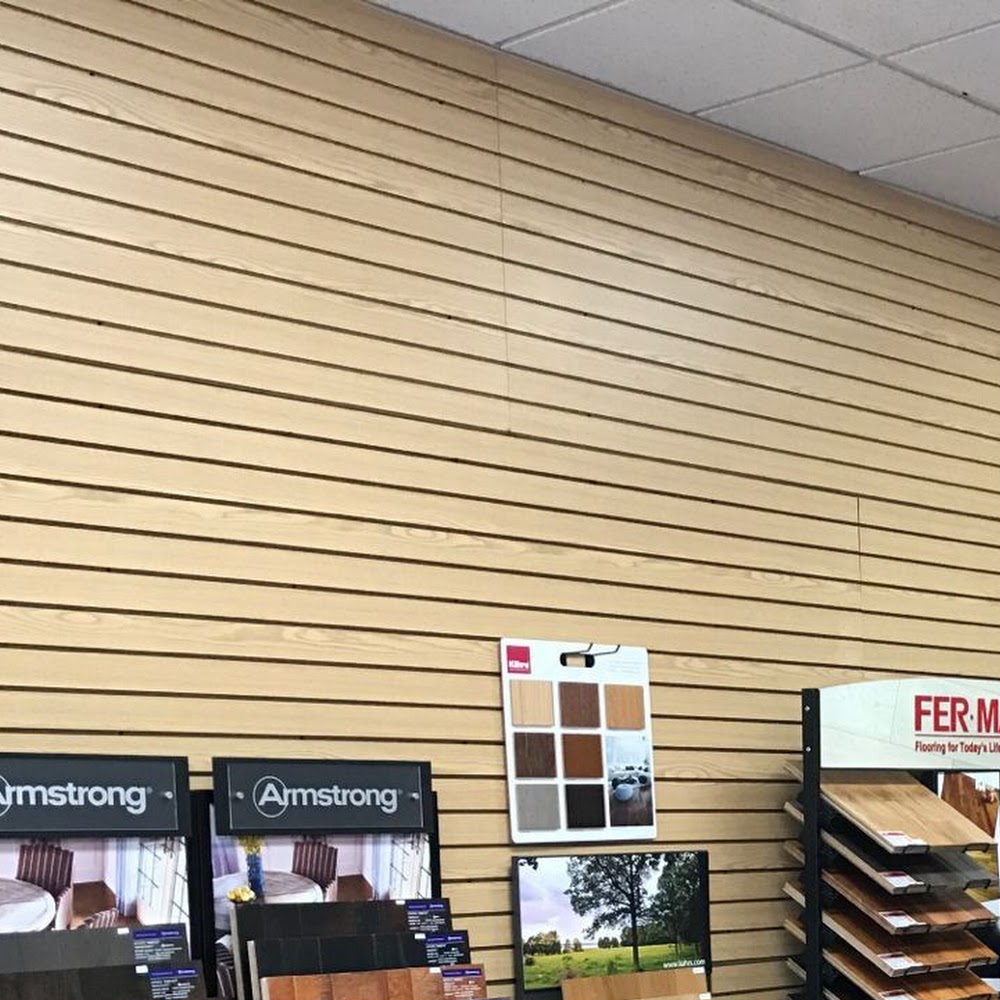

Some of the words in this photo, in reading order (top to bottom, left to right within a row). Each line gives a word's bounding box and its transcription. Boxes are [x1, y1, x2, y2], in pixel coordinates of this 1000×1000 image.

[915, 741, 946, 755] Flooring
[948, 742, 958, 752] for
[959, 742, 987, 755] Today's
[254, 776, 398, 818] Armstrong
